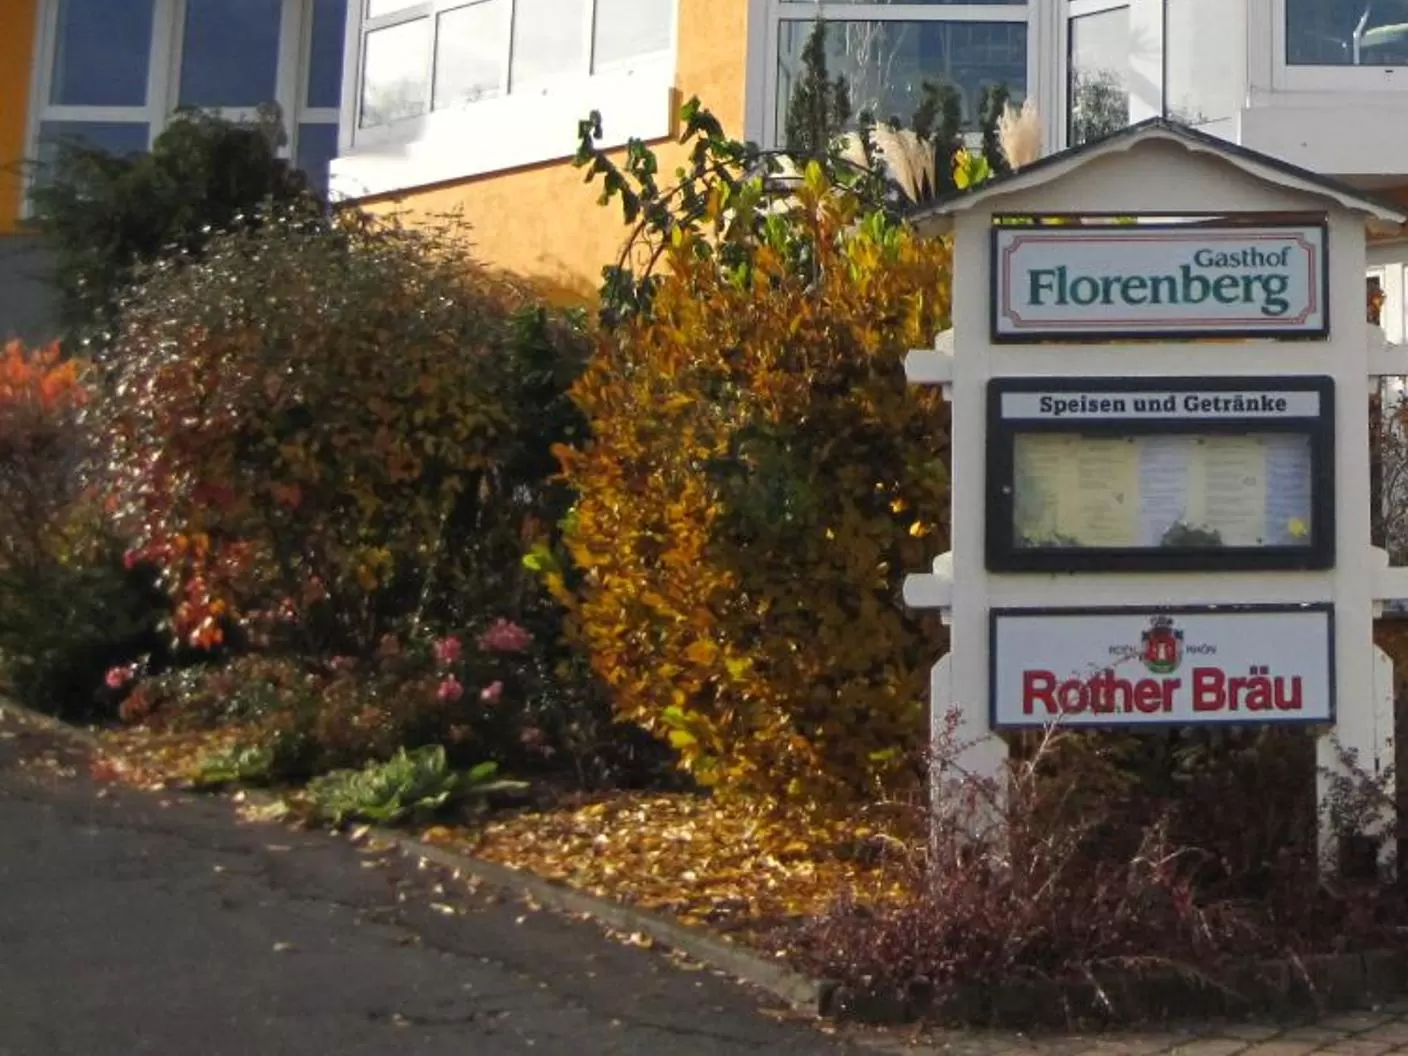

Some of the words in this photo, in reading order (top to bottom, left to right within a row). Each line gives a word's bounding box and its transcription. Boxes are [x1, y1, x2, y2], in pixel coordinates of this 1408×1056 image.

[1193, 246, 1291, 269] Gasthof
[1027, 264, 1290, 316] Florenberg
[1039, 396, 1127, 415] Speisen
[1133, 395, 1177, 412] und
[1183, 394, 1287, 412] Getränke
[1022, 668, 1182, 715] Rother
[1192, 665, 1303, 712] Bräu
